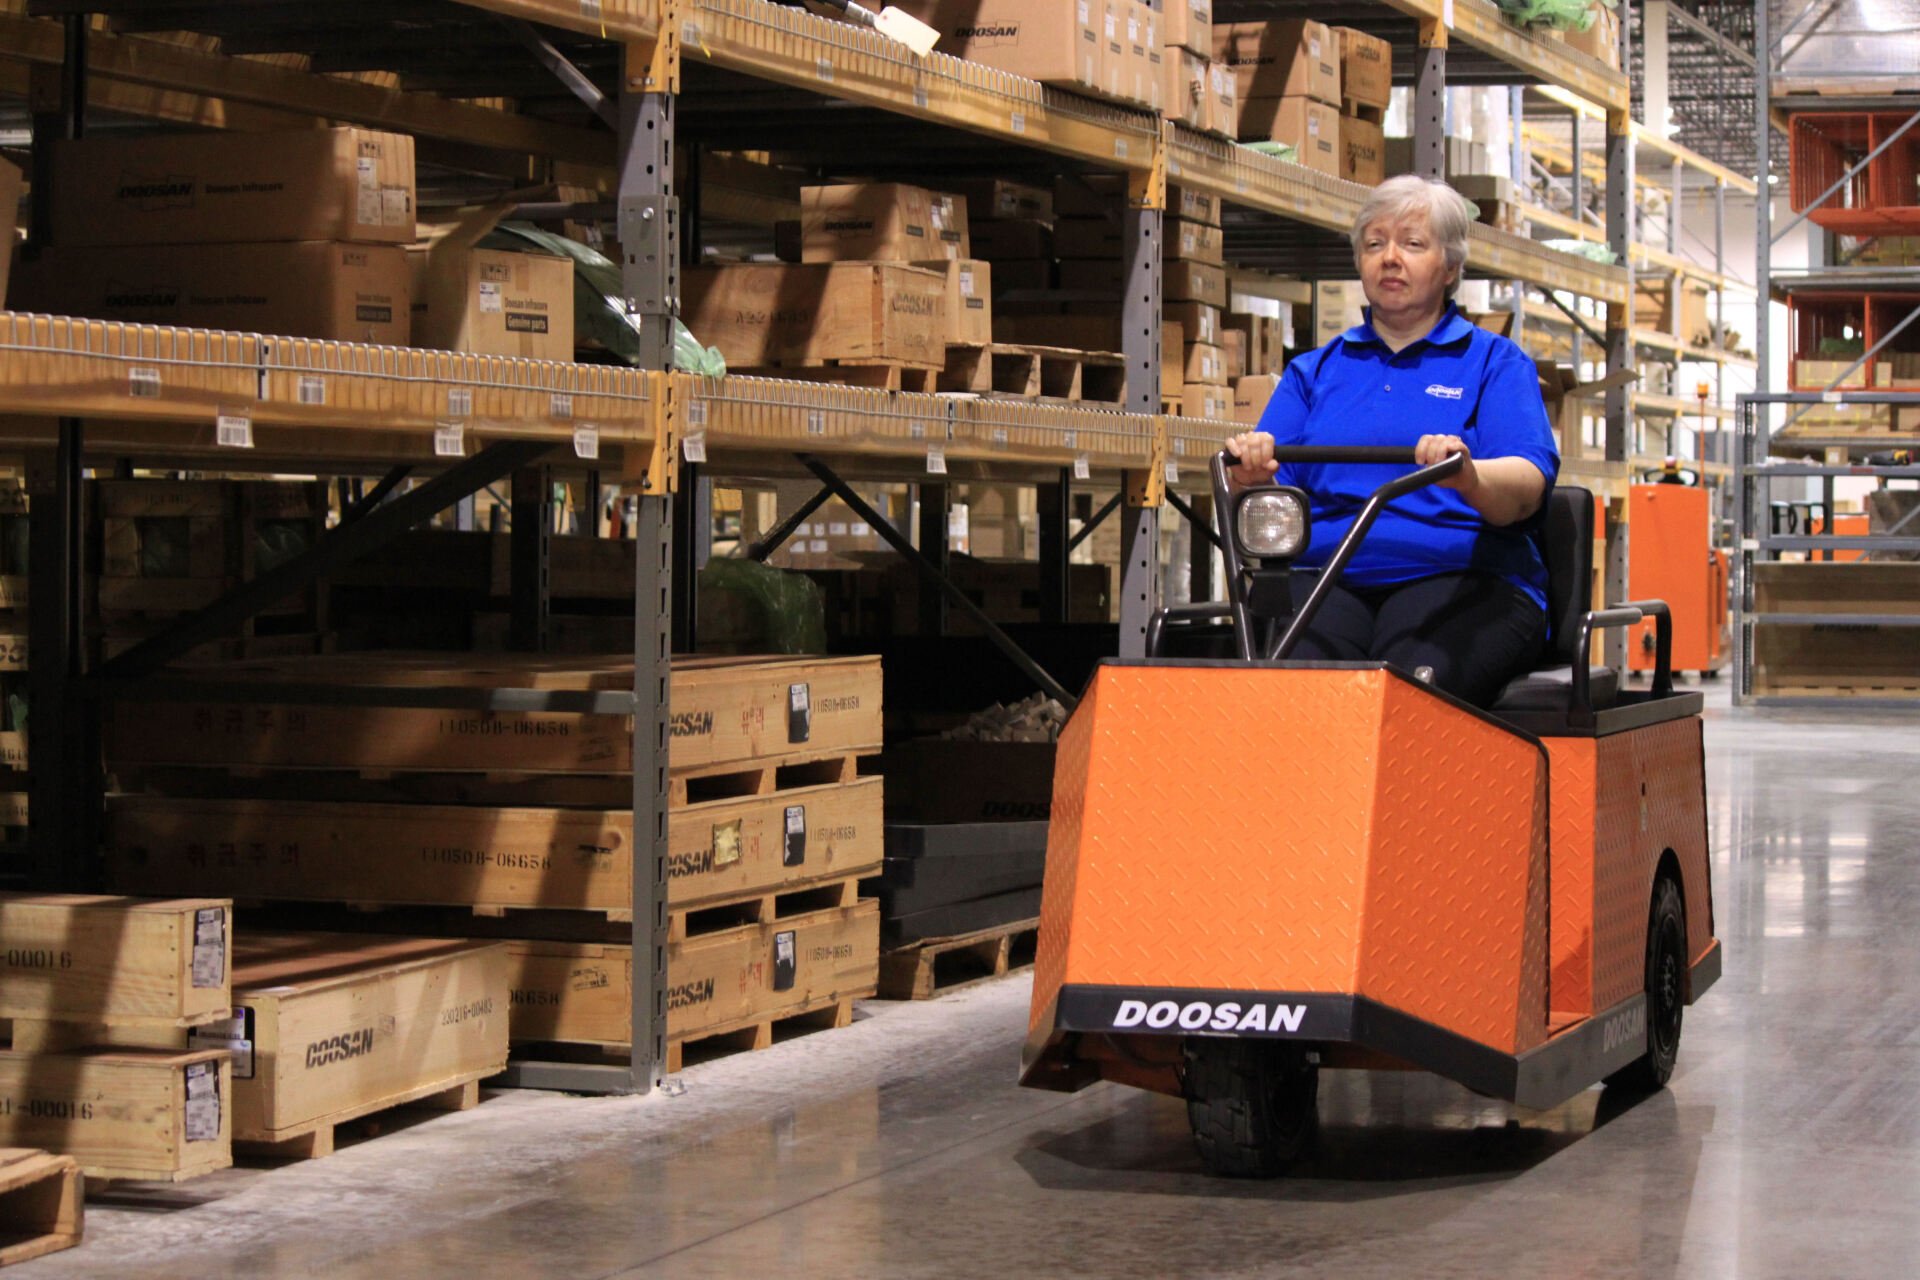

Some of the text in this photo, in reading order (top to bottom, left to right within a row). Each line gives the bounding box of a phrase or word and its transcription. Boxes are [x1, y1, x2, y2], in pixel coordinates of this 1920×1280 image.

[955, 26, 1018, 37] DOOSAN
[119, 182, 193, 198] DOOSAN
[822, 221, 873, 231] DOOSAN
[892, 292, 933, 316] DOOSAN
[670, 711, 714, 737] OOSAN
[421, 849, 552, 870] 110508-06658
[668, 849, 713, 878] OOSAN
[666, 977, 715, 1010] OOSAN
[1112, 1000, 1308, 1032] DOOSAN
[1603, 1004, 1646, 1053] DOOSAN
[305, 1027, 374, 1070] DOOSAN
